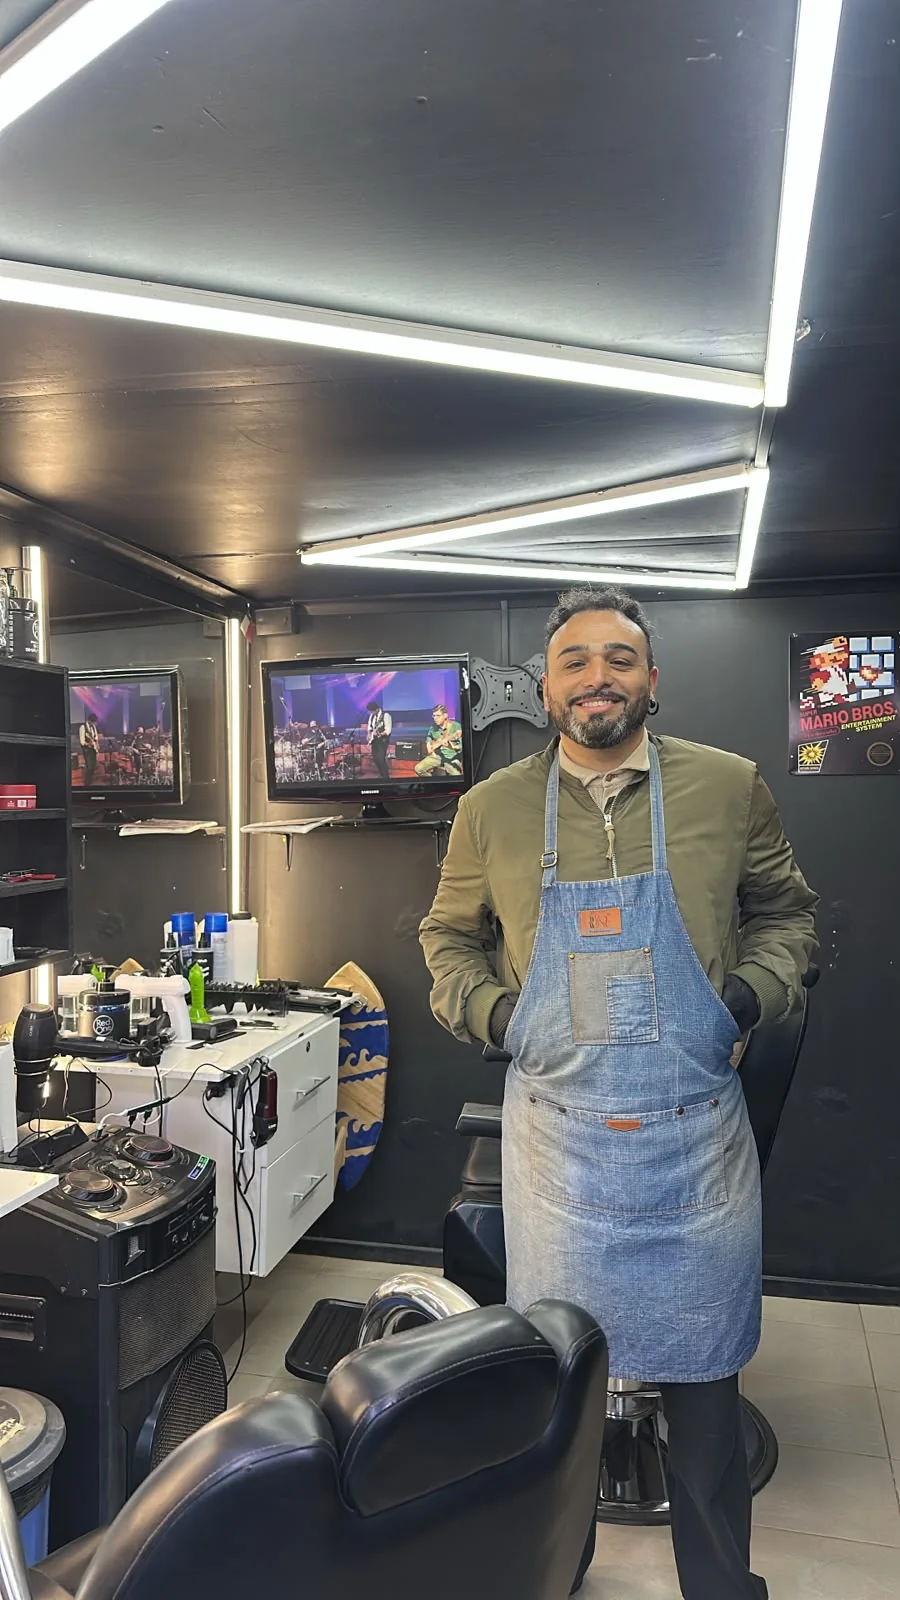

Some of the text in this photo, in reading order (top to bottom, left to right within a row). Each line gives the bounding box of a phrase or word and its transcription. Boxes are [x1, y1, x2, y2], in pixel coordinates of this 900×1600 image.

[800, 709, 849, 731] MARIO
[841, 714, 897, 730] ENTERTAINMENT
[855, 722, 883, 733] SYSTEM
[96, 1019, 110, 1027] Red
